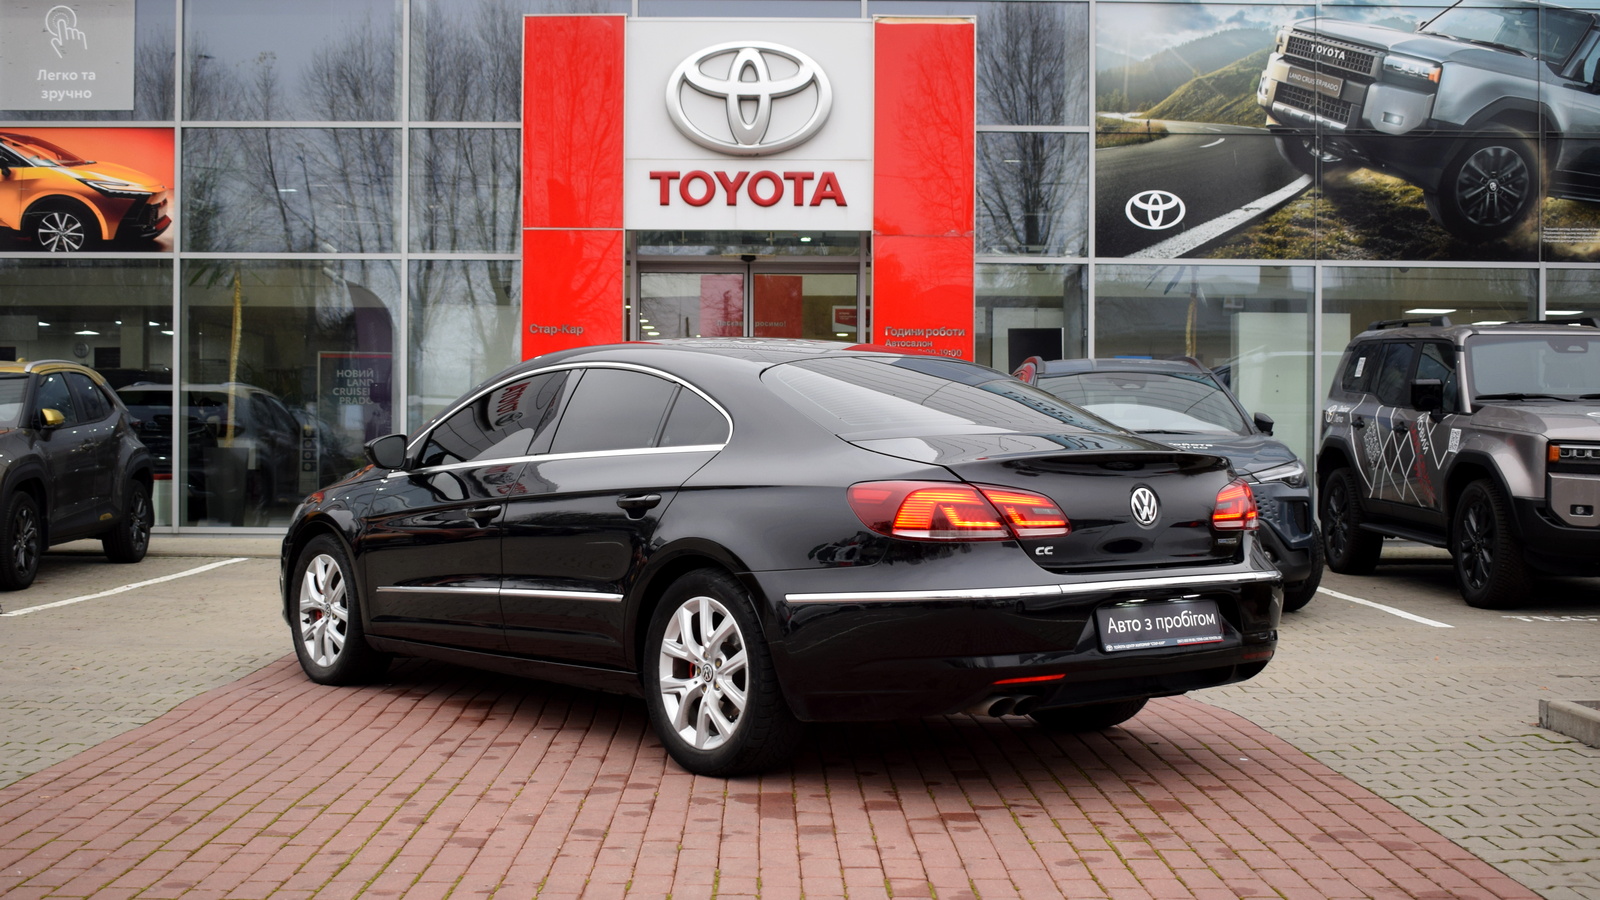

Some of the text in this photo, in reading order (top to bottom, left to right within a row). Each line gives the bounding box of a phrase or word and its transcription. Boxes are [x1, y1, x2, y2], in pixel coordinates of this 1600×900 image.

[1310, 44, 1345, 60] TOYOTA
[37, 69, 96, 81] Легко та
[1289, 72, 1302, 81] LAND
[1323, 80, 1338, 91] PRADO
[41, 90, 92, 102] зручно
[649, 170, 848, 207] TOYOTA
[529, 323, 584, 336] Стар-Кар
[755, 320, 787, 328] росимо!
[884, 325, 966, 339] Години роботи
[885, 339, 933, 347] Автосалон
[336, 368, 374, 378] НОВИЙ
[1035, 545, 1054, 556] CC
[1107, 609, 1216, 634] Авто з пробігом
